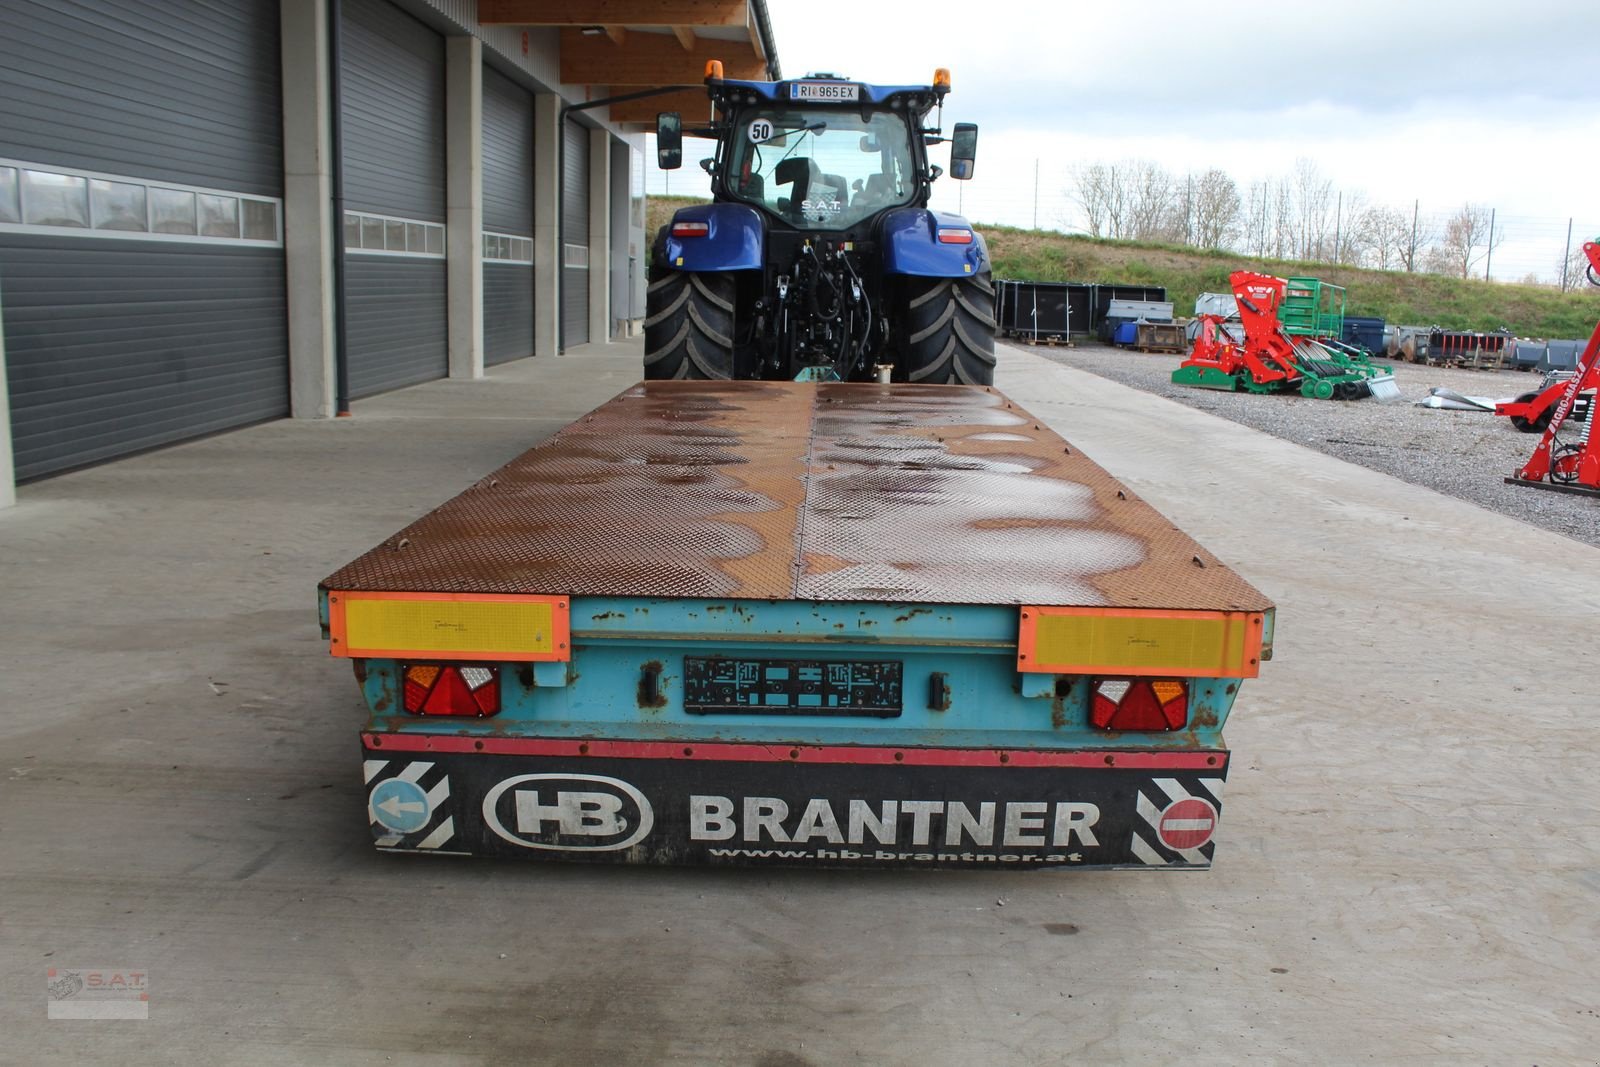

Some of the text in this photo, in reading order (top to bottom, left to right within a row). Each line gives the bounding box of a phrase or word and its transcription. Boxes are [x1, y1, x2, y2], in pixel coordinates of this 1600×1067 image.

[752, 123, 770, 140] 50
[801, 200, 841, 210] S.A.T.
[1553, 370, 1584, 427] AGRO-MASZ
[515, 789, 628, 837] HB
[690, 794, 1100, 847] BRANTNER
[708, 848, 1083, 863] www.hb-brantner.at
